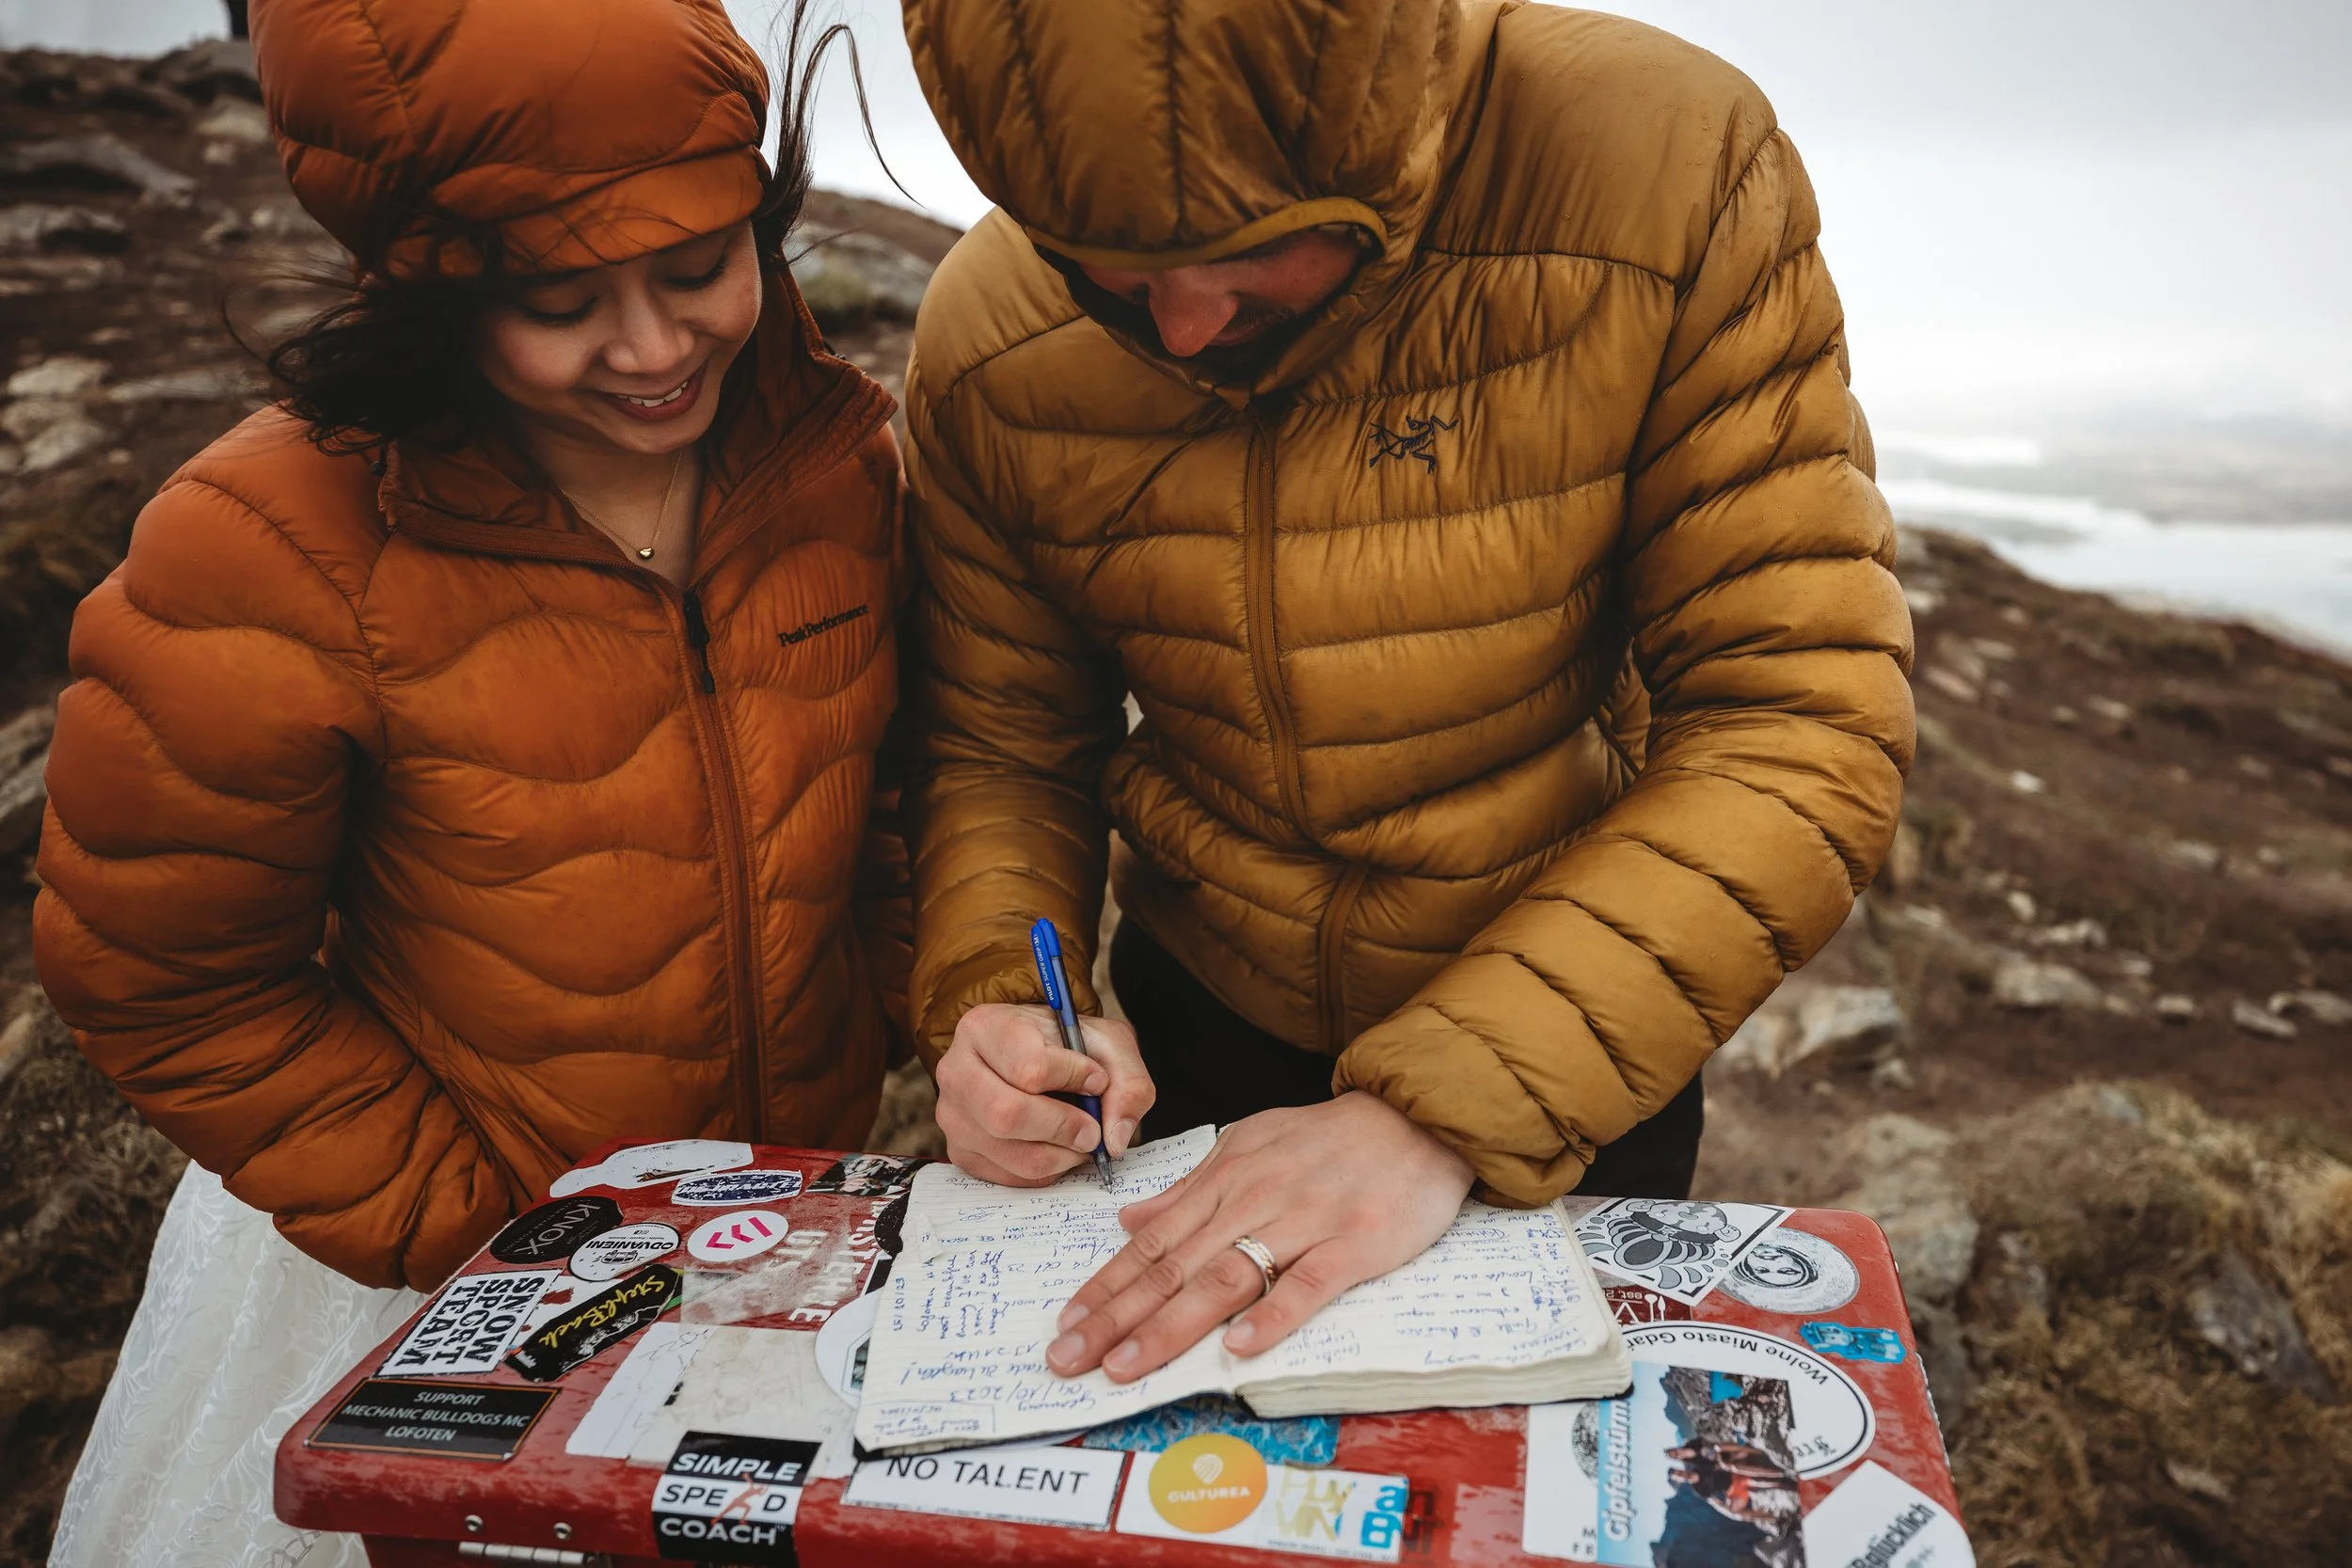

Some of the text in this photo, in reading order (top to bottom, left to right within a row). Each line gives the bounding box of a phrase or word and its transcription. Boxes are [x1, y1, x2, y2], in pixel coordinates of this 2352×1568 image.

[779, 629, 806, 647] Peak
[1045, 982, 1054, 1001] PILOT
[515, 1203, 601, 1256] KNOX
[585, 1240, 675, 1250] ODVANIENI
[393, 1285, 480, 1367] TEAM
[431, 1278, 501, 1367] SPORT
[462, 1276, 546, 1364] SNOW
[1682, 1332, 1757, 1352] Miasto
[1766, 1346, 1829, 1385] Wolne
[414, 1391, 485, 1405] SUPPORT
[342, 1404, 531, 1428] MECHANIC BULLDOGS MC
[385, 1426, 457, 1441] LOFOTEN
[672, 1452, 802, 1481] SIMPLE
[886, 1457, 1089, 1494] NO TALENT
[660, 1517, 777, 1546] COACH
